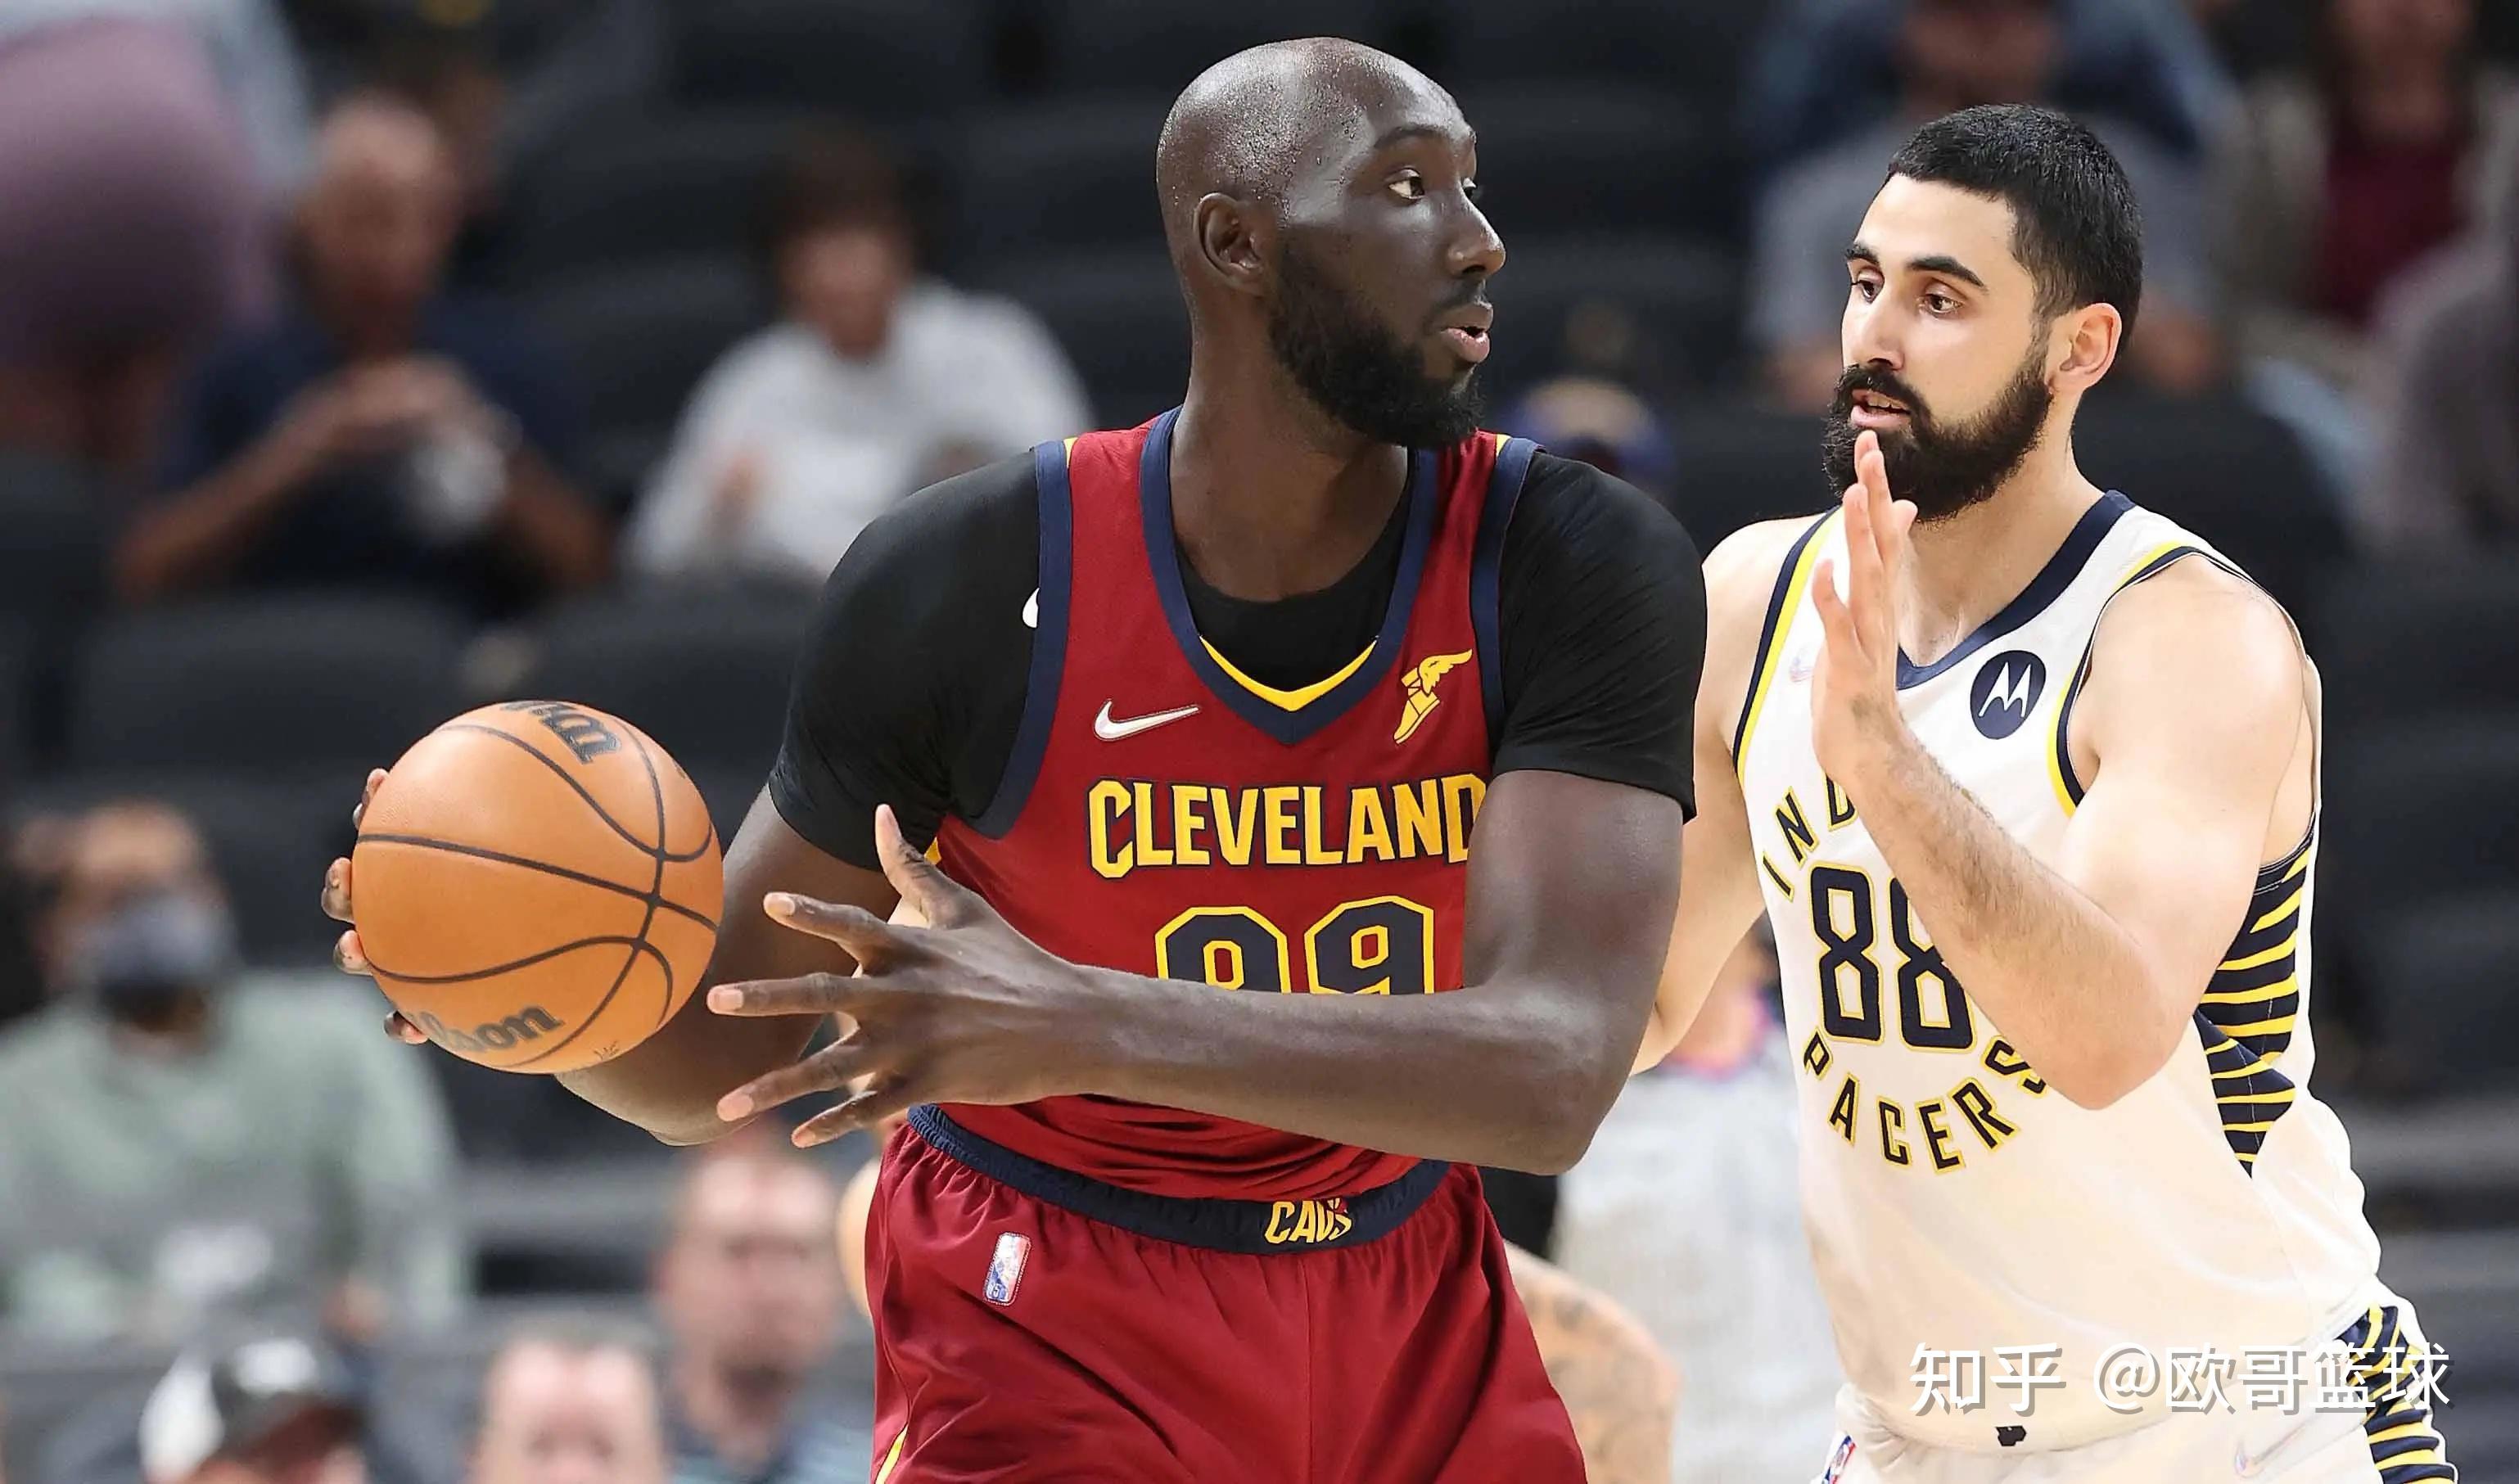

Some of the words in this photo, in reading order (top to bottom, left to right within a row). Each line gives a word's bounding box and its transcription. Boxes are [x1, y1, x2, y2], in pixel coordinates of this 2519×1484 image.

[1087, 773, 1487, 880] CLEVELAND
[1762, 774, 1857, 901] IND
[1808, 863, 1975, 1052] 88
[1802, 1025, 2046, 1174] PACERS
